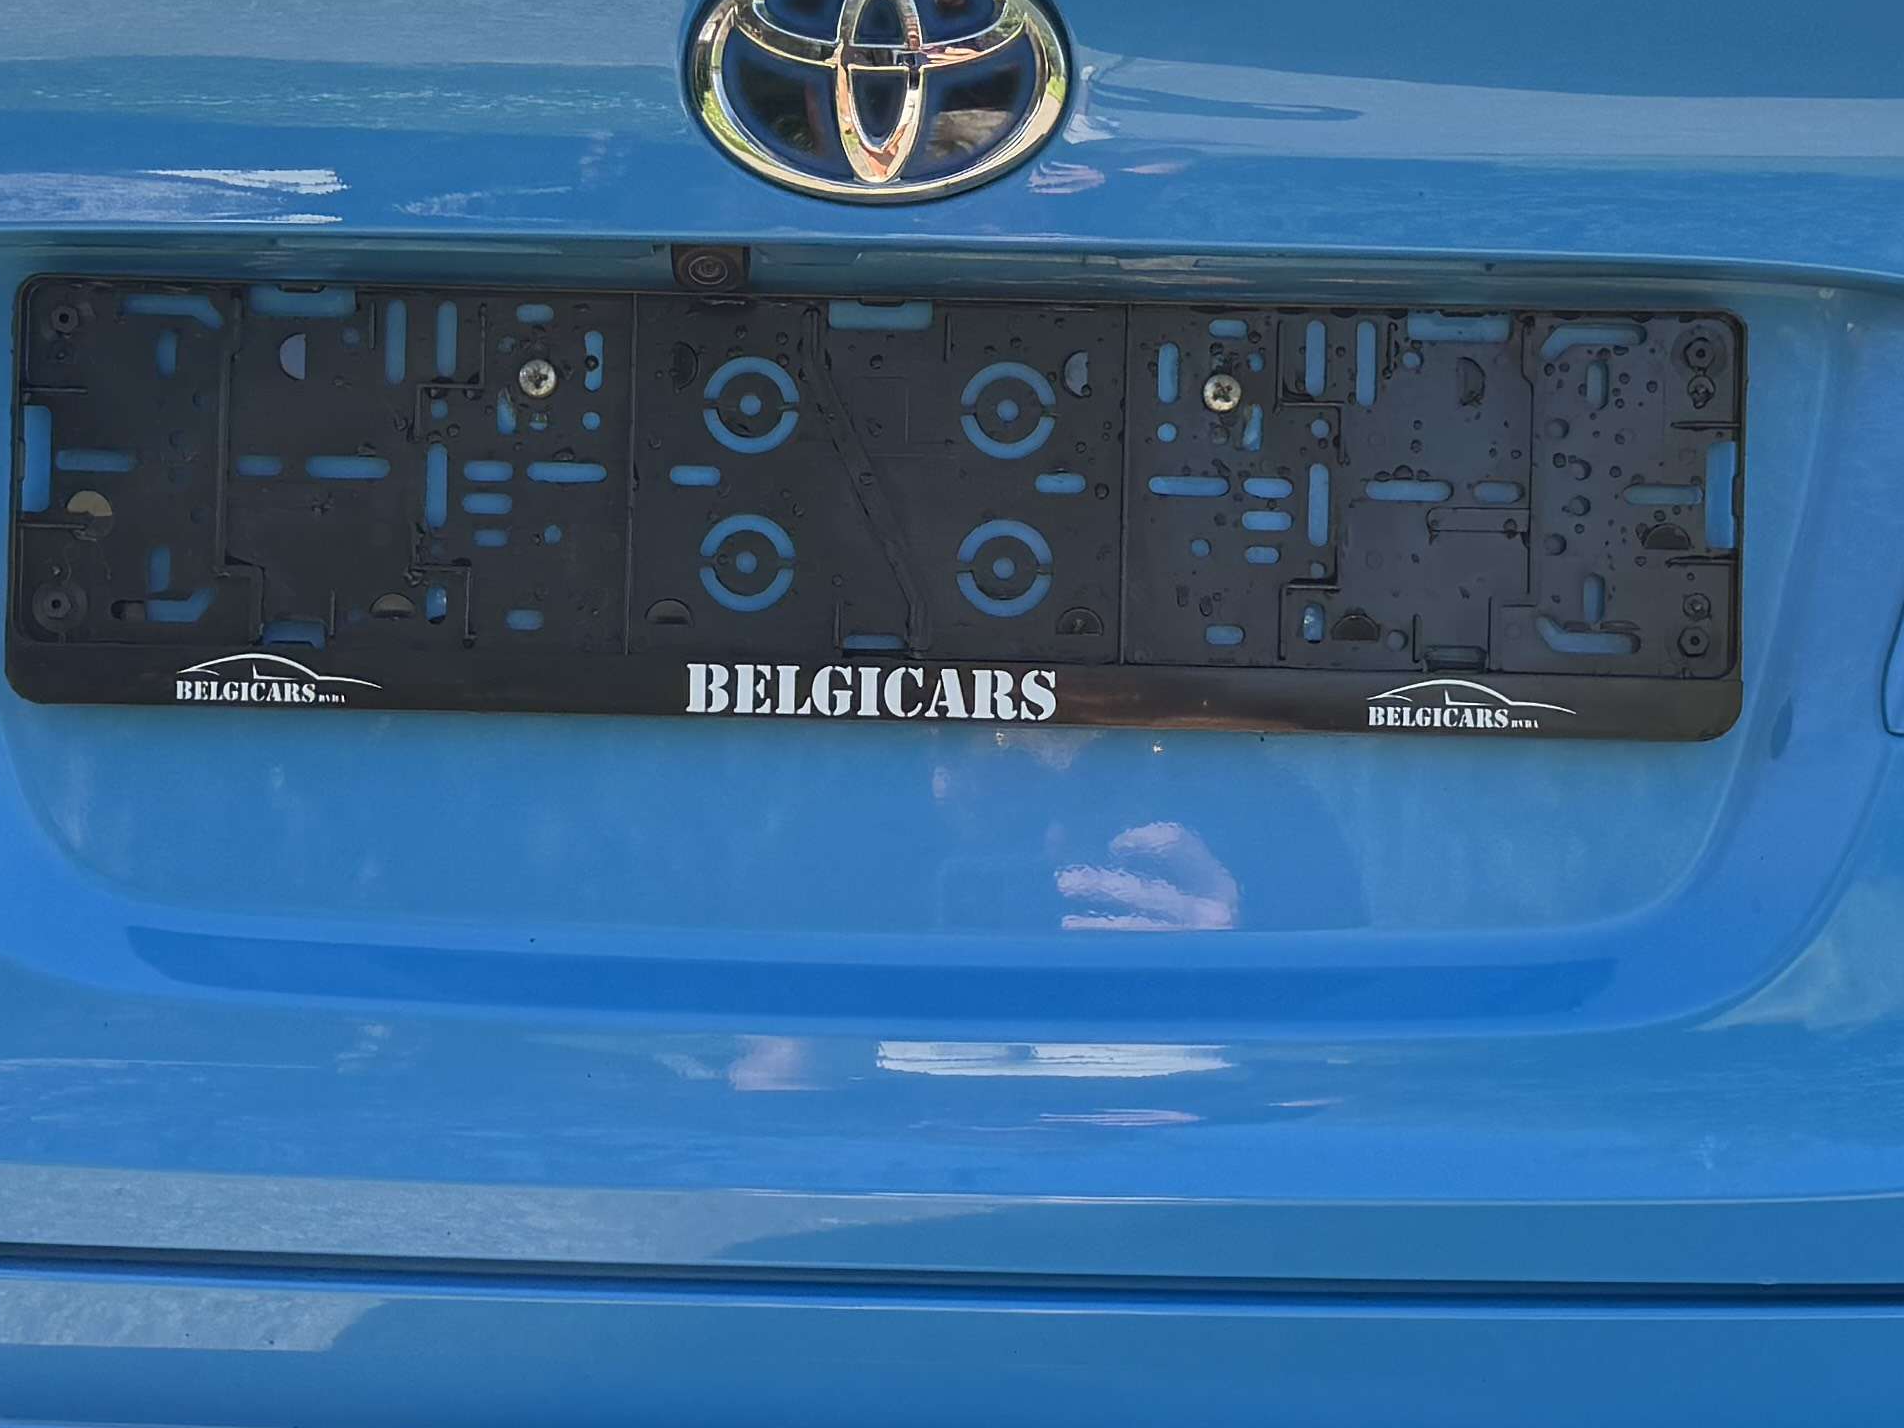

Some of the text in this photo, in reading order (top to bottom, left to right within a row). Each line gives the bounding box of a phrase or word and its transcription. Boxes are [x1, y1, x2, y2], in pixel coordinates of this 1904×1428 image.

[176, 680, 316, 703] BELGICARS
[685, 663, 1057, 721] BELGICARS
[1368, 706, 1509, 729] BELGICARS
